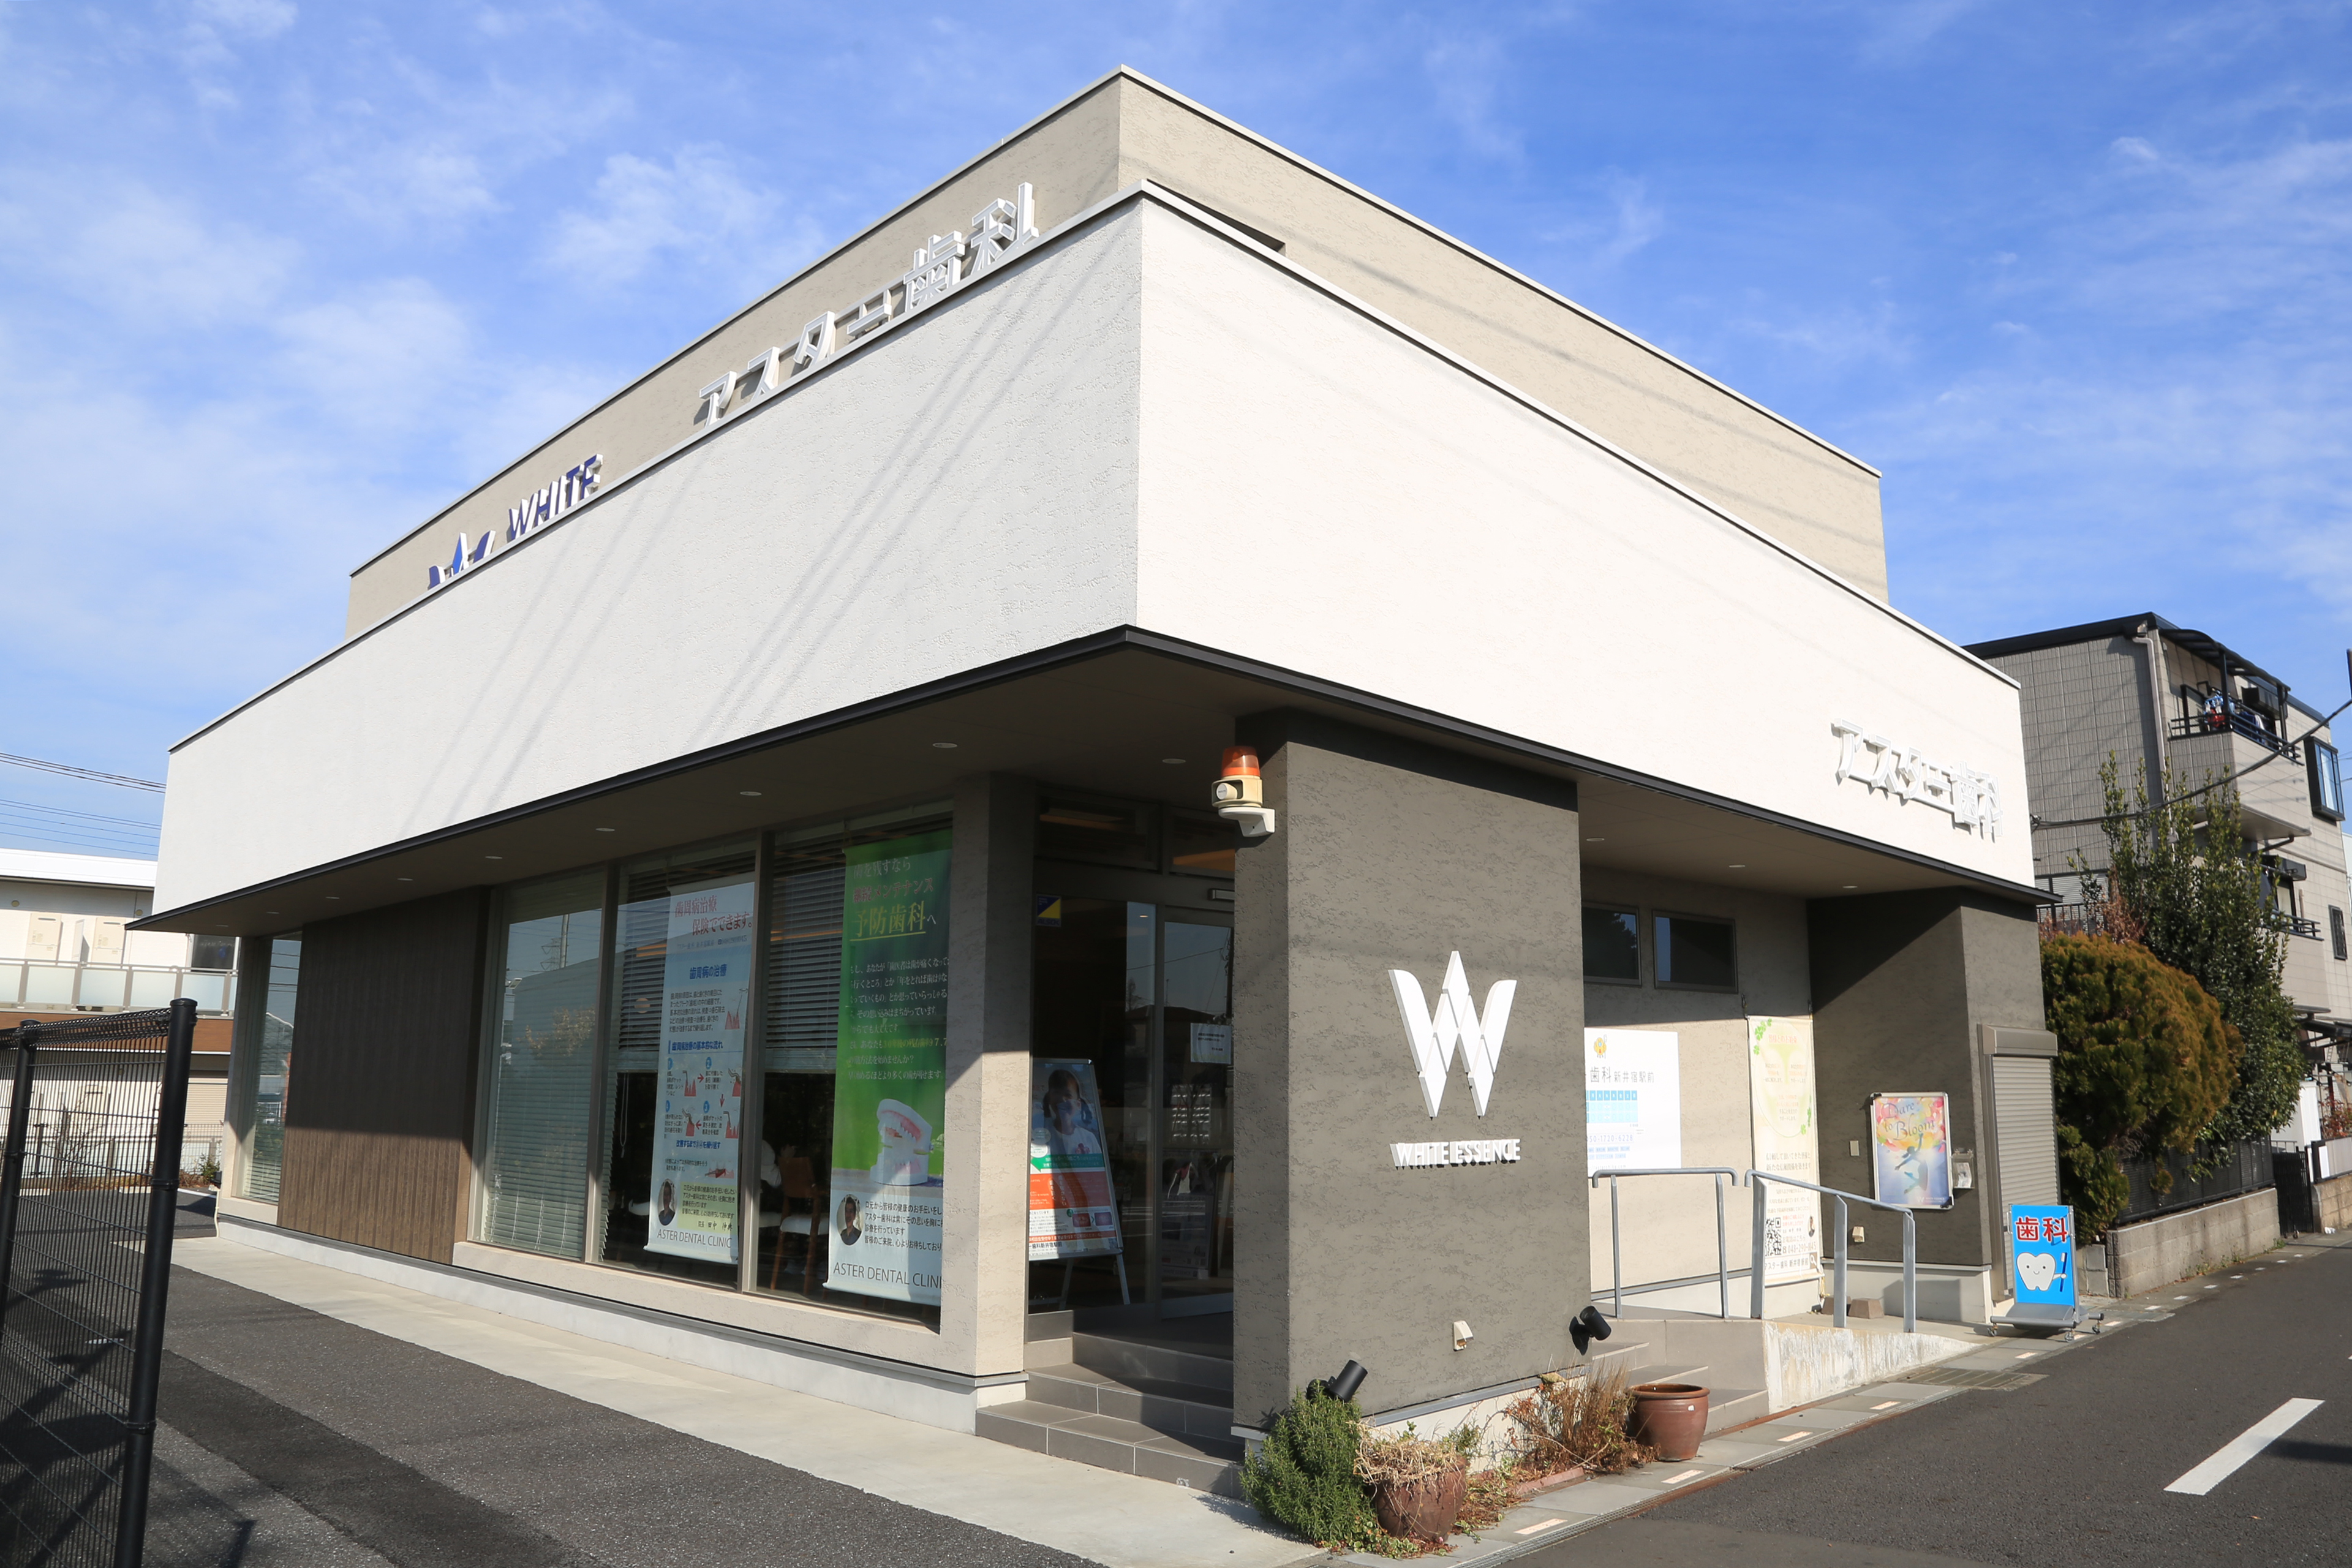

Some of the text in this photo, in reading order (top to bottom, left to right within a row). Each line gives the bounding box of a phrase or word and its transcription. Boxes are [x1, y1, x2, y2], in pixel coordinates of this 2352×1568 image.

[699, 182, 1039, 427] アスター歯科
[509, 454, 603, 540] WHITE
[1833, 718, 2003, 837] アスター歯科
[853, 877, 934, 903] 継続メンテナンス
[675, 895, 717, 918] 歯周病治療
[692, 911, 752, 935] 保険でできます。
[851, 900, 936, 938] 予防歯科へ
[690, 963, 728, 979] 歯周病の治療
[1590, 1066, 1654, 1083] 歯科 新井宿駅前
[1881, 1102, 1915, 1120] Dare
[1884, 1113, 1935, 1140] to Bloom
[1390, 1139, 1521, 1167] WHITE ESSENCE
[865, 1201, 943, 1216] 口元から皆様の健康のお手伝いをし
[657, 1229, 733, 1248] ASTER DENTAL CLINIC
[865, 1224, 906, 1236] 診療を行っています
[2016, 1216, 2067, 1243] 歯科
[865, 1235, 942, 1251] 皆様のご来院、心よりお待ちしており
[834, 1262, 865, 1278] ASTER
[867, 1267, 910, 1285] DENTAL
